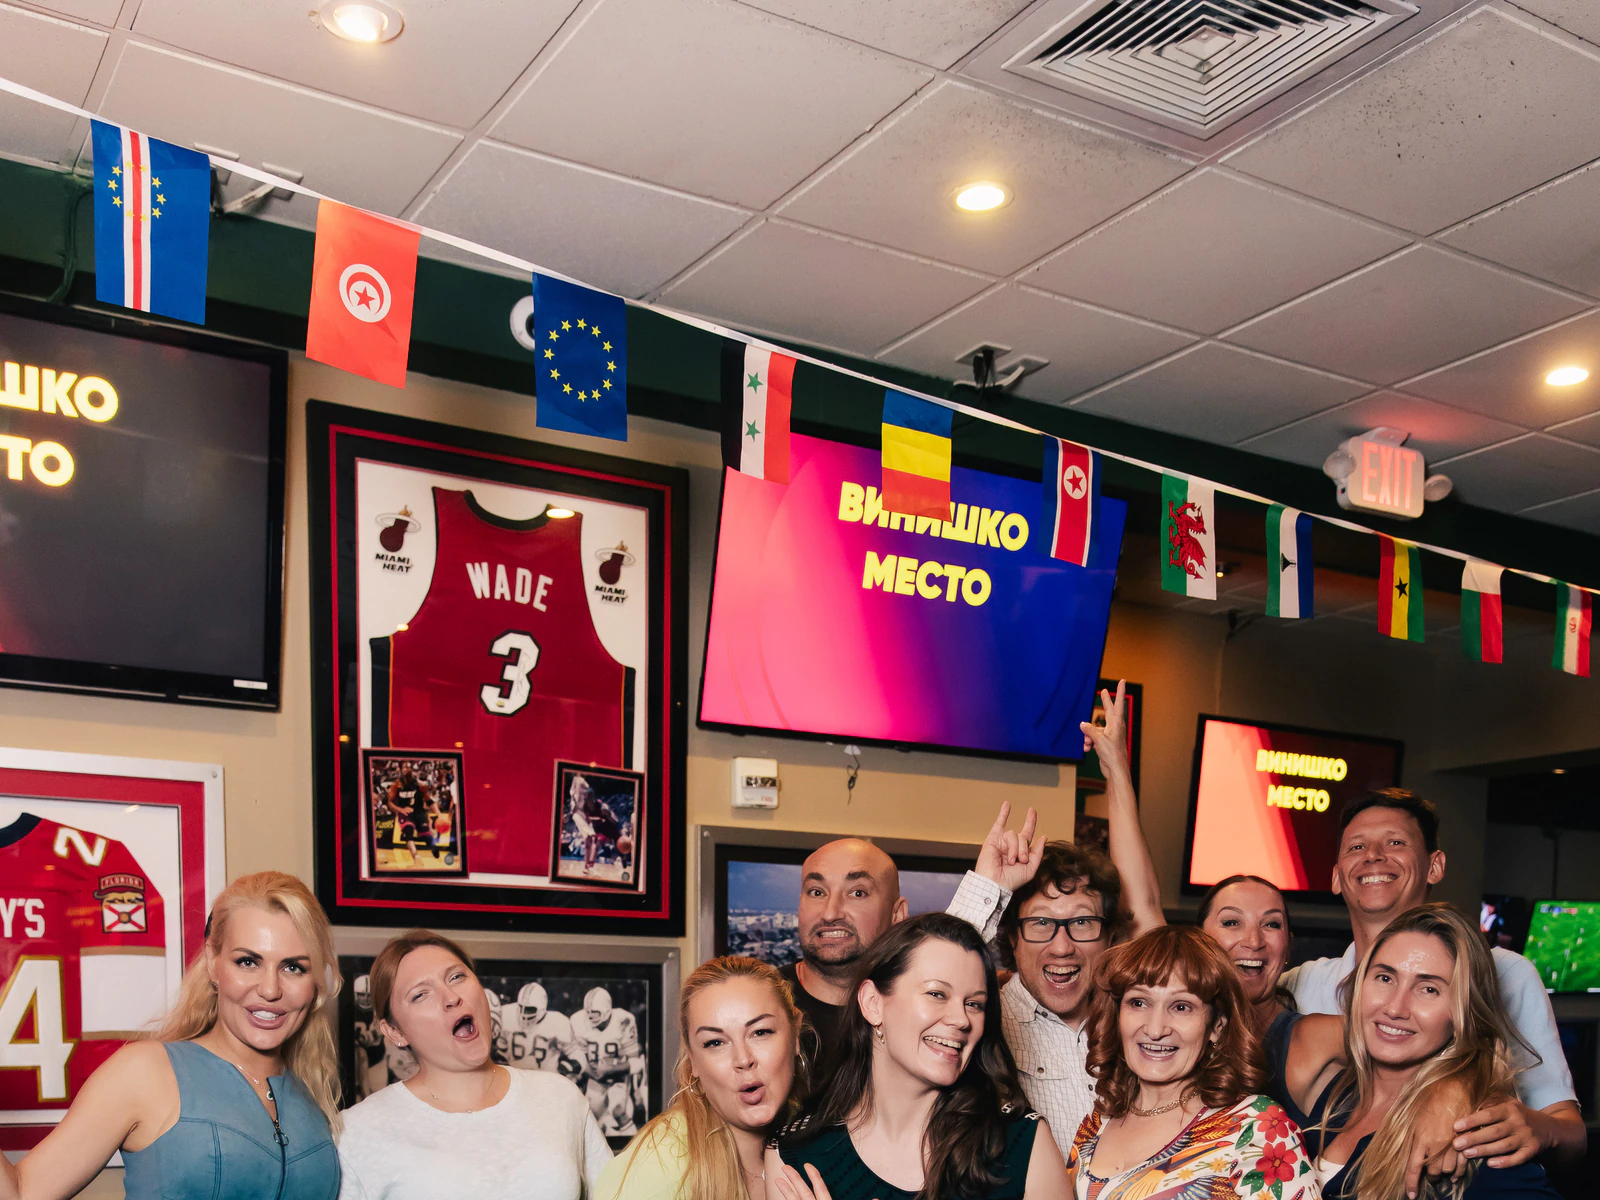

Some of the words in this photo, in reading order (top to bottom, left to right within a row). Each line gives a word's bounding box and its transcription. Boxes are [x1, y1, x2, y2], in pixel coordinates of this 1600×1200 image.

[1362, 441, 1417, 511] EXIT
[375, 553, 411, 566] MIAMI
[383, 562, 411, 574] HEAT
[466, 561, 553, 613] WADE
[595, 585, 626, 597] MIAMI
[862, 551, 992, 607] МЕСТО
[601, 594, 627, 605] HEAT
[479, 629, 542, 717] 3
[1256, 748, 1348, 782] ВИНИШКО
[1266, 784, 1331, 813] МЕСТО
